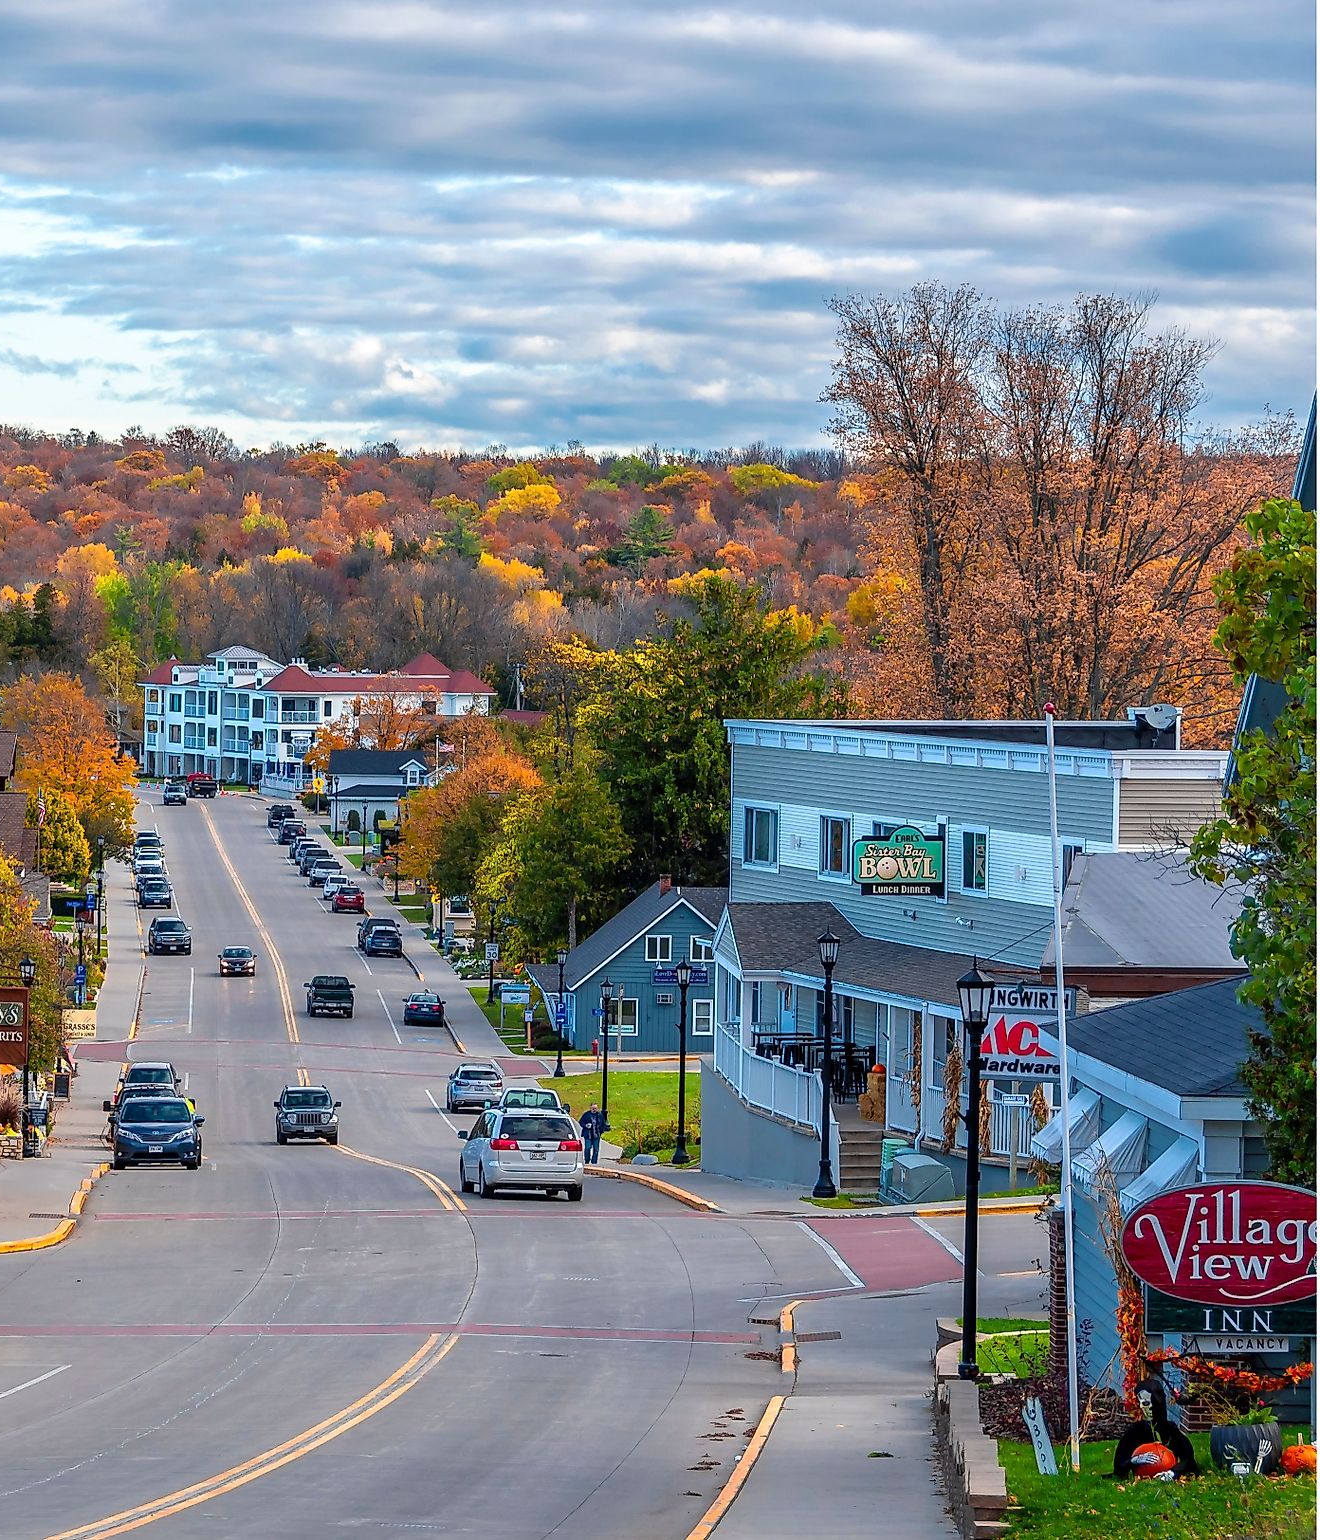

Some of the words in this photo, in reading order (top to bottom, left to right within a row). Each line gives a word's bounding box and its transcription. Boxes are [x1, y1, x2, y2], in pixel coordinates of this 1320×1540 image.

[895, 833, 920, 843] EARL'S
[865, 844, 901, 857] Sister
[902, 844, 926, 859] Bay
[859, 856, 937, 880] BOWL
[558, 1004, 564, 1012] P
[1202, 1309, 1274, 1333] INN
[1216, 1338, 1285, 1349] VACANCY
